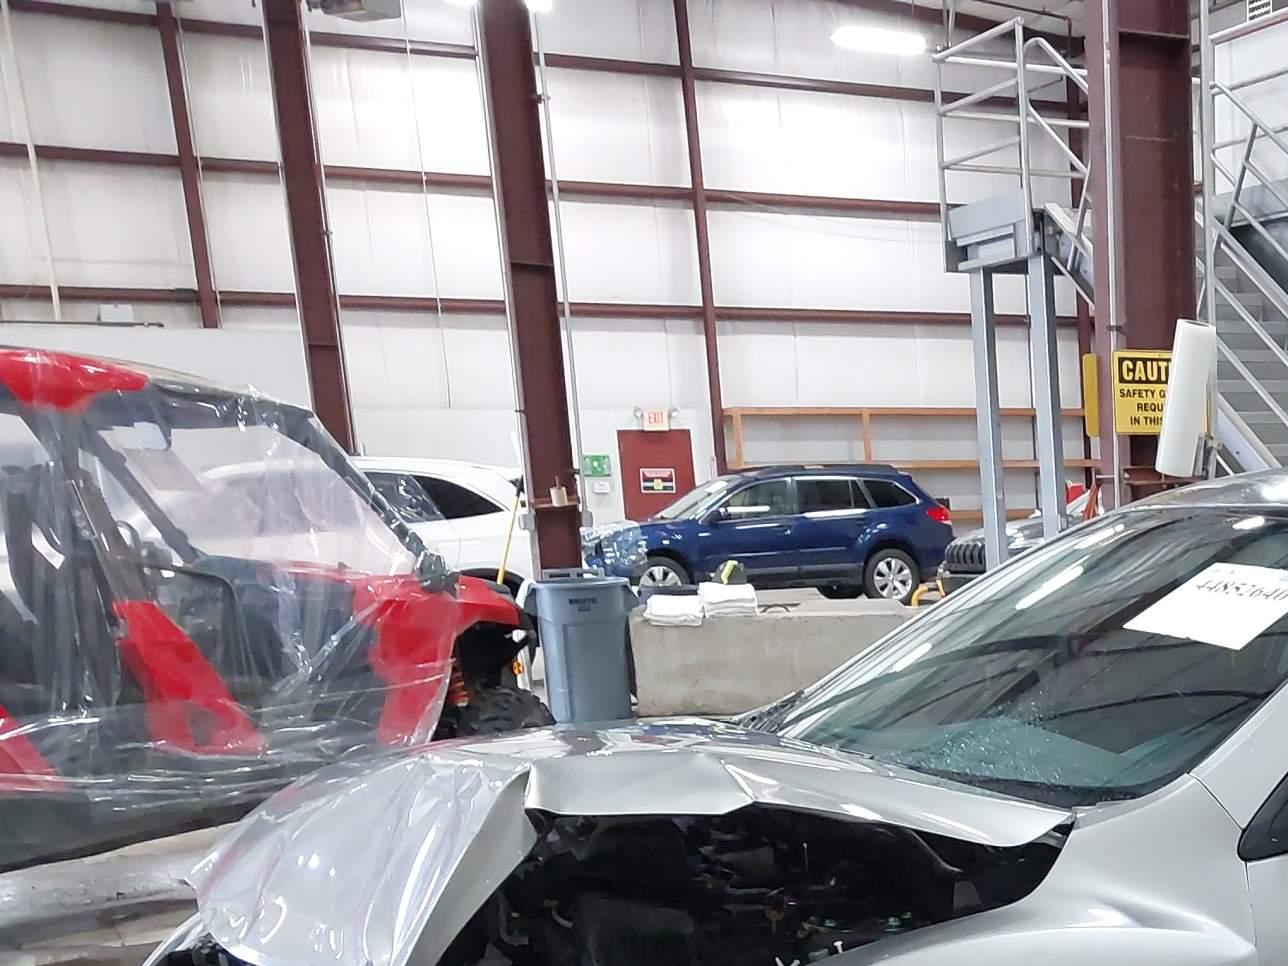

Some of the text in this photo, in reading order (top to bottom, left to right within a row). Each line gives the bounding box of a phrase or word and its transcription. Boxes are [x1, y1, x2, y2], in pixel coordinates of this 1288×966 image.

[1122, 360, 1171, 382] CAUT
[1119, 388, 1156, 399] SAFETY
[648, 410, 664, 425] EXIT
[1130, 416, 1140, 426] IN
